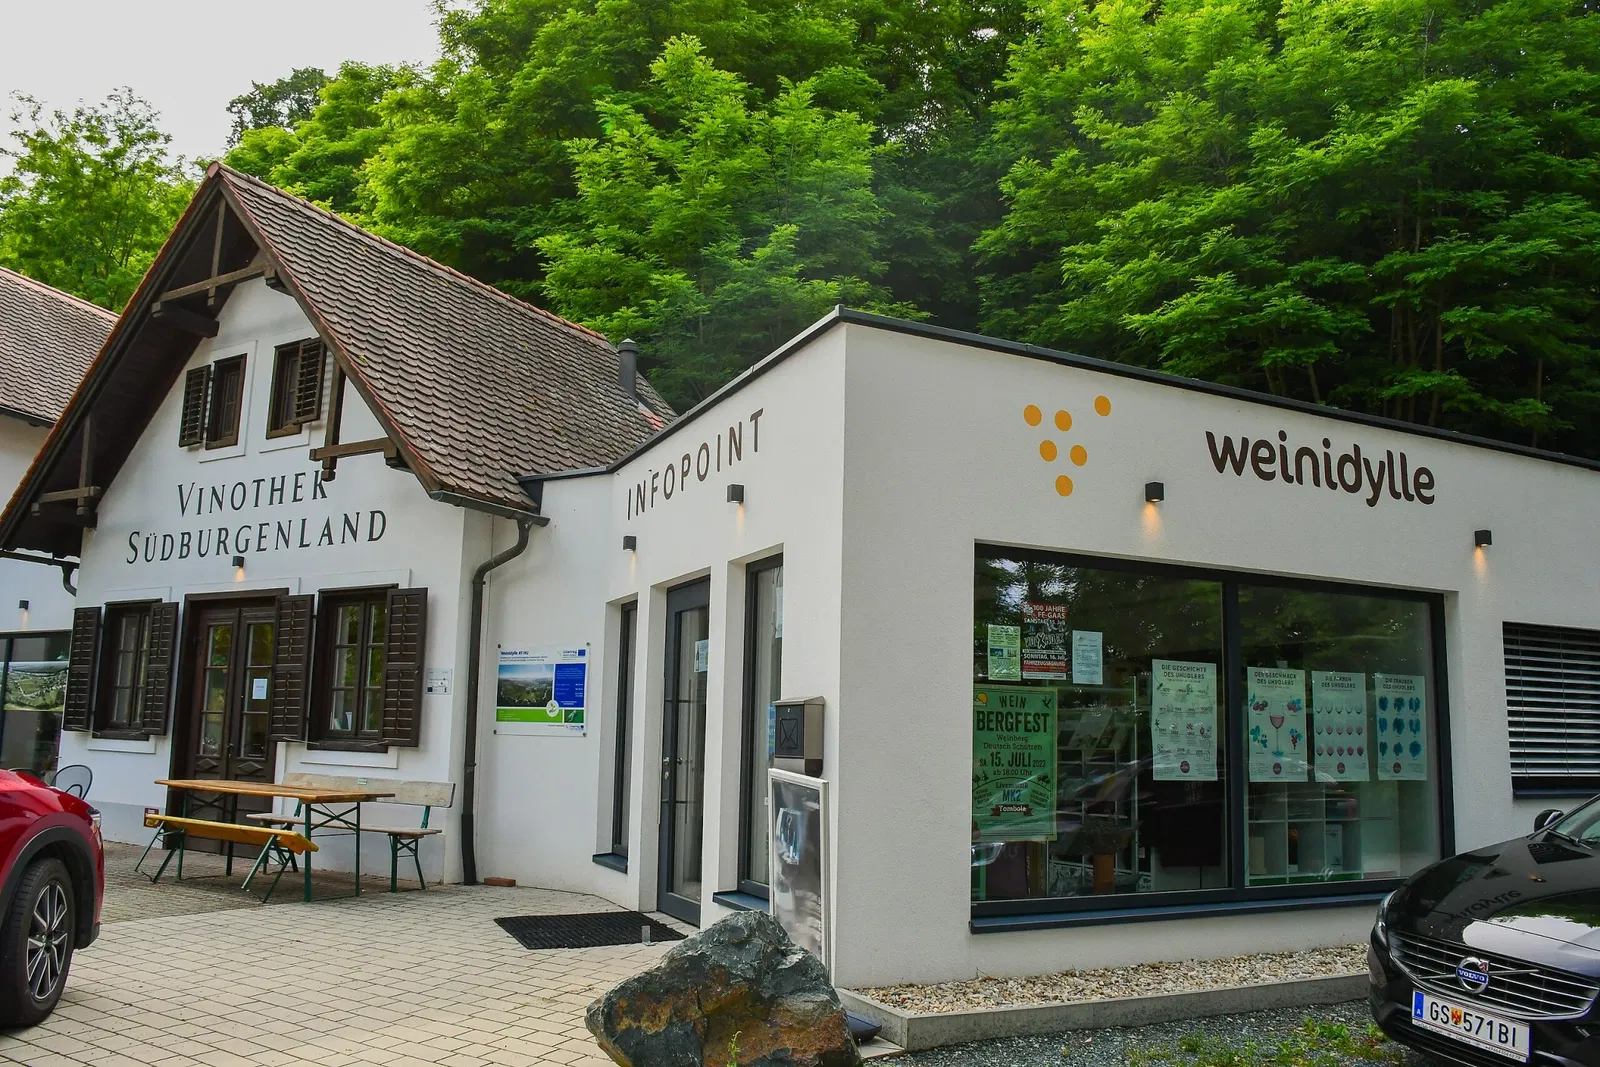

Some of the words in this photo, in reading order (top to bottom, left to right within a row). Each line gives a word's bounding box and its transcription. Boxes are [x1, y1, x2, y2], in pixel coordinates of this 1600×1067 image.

[627, 407, 764, 521] INFOPOINT
[1205, 429, 1436, 508] weinidylle
[177, 470, 328, 517] VINOTHEK
[126, 509, 387, 565] SÜDBURGENLAND
[1172, 665, 1207, 673] GESCHICHTE
[1176, 672, 1205, 680] UHUDLERS
[999, 695, 1027, 709] WEIN
[976, 710, 1050, 734] BERGFEST
[984, 742, 1011, 750] Deutsch
[997, 734, 1028, 744] Weinberg
[990, 752, 1004, 767] 15.
[1008, 752, 1032, 768] JULI
[1002, 790, 1021, 802] MK2
[1458, 968, 1486, 982] VOLVO
[1416, 1008, 1422, 1016] A
[1429, 1001, 1450, 1026] GS
[1462, 1012, 1517, 1048] 571BI
